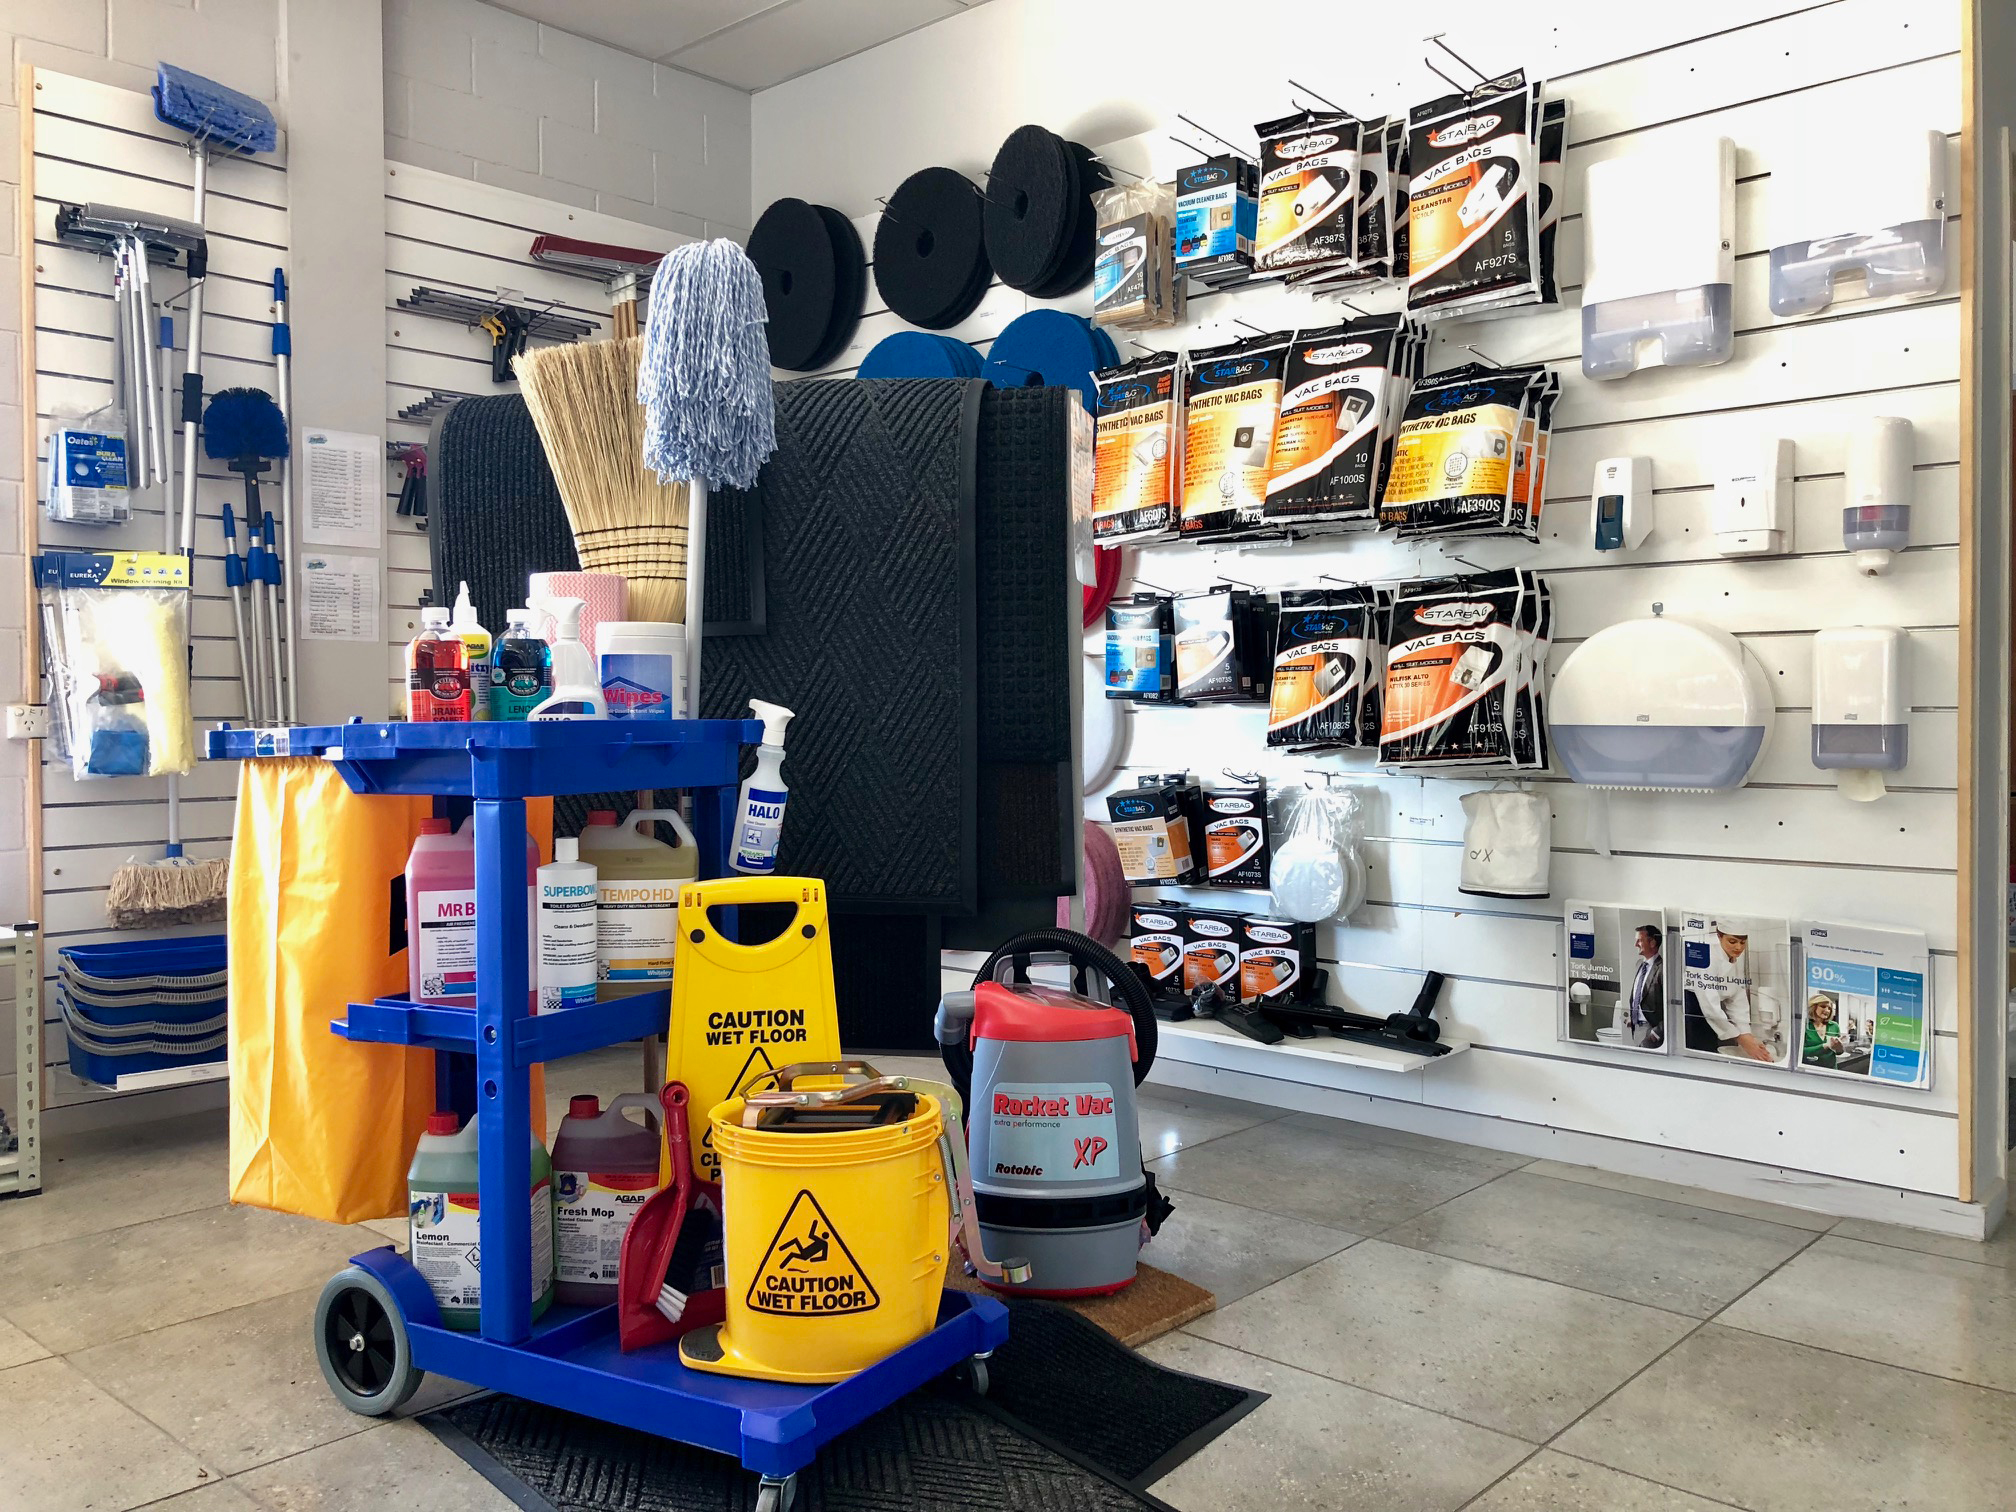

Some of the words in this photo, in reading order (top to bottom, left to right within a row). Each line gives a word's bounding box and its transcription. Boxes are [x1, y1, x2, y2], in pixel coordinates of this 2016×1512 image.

[1268, 168, 1291, 182] VAC
[1296, 157, 1329, 171] BAGS
[1424, 162, 1451, 181] VAC
[1456, 146, 1492, 166] BAGS
[1193, 172, 1218, 184] STARBAG
[1412, 191, 1427, 201] WILL
[1428, 187, 1442, 197] SUIT
[1443, 180, 1469, 193] MODELS
[1178, 198, 1195, 208] VACUUM
[1196, 194, 1215, 204] CLEANER
[1215, 191, 1228, 201] BAGS
[1412, 197, 1453, 214] CLEANSTAR
[1338, 214, 1344, 223] 5
[1370, 214, 1376, 223] 5
[1313, 233, 1345, 246] AF387S
[1358, 232, 1380, 245] 387S
[1401, 234, 1407, 243] 5
[1504, 231, 1513, 242] 5
[1218, 253, 1234, 263] AF1082
[1475, 253, 1517, 272] AF927S
[1214, 364, 1253, 378] STARBAG
[1295, 382, 1320, 399] VAC
[1325, 375, 1360, 389] BAGS
[1224, 392, 1240, 405] VAC
[1240, 388, 1263, 403] BAGS
[1130, 414, 1144, 427] VAC
[1145, 410, 1164, 423] BAGS
[1451, 413, 1477, 426] BAGS
[67, 436, 94, 446] Oates
[1356, 453, 1367, 463] 10
[1330, 474, 1365, 486] AF1000S
[1461, 499, 1500, 514] AF390S
[1388, 511, 1408, 522] BAGS
[1425, 605, 1489, 619] STARBAG
[1405, 637, 1436, 651] VAC
[1442, 632, 1486, 643] BAGS
[1287, 647, 1307, 659] VAC
[1311, 642, 1339, 652] BAGS
[1390, 675, 1411, 683] NILFISK
[602, 688, 663, 708] Wipes
[432, 707, 464, 716] ORANGE
[1345, 702, 1350, 712] 5
[1366, 703, 1372, 712] 5
[1494, 701, 1500, 710] 5
[1516, 708, 1523, 717] 5
[1320, 722, 1350, 731] AF1082S
[1467, 723, 1503, 735] AF913S
[748, 804, 780, 819] HALO
[1254, 859, 1260, 867] 5
[599, 889, 651, 901] TEMPO
[652, 889, 674, 900] HD
[438, 903, 463, 917] MR
[1141, 918, 1174, 927] STARBAG
[1194, 924, 1229, 933] STARBAG
[1251, 930, 1288, 940] STARBAG
[1570, 961, 1586, 971] Tork
[1588, 964, 1614, 973] Jumbo
[1570, 970, 1580, 978] T1
[1581, 971, 1609, 981] System
[1685, 971, 1702, 980] Tork
[1704, 973, 1725, 985] Soap
[1727, 976, 1752, 986] Liquid
[1811, 966, 1846, 983] 90%
[1685, 979, 1695, 987] S1
[1697, 981, 1728, 992] System
[708, 1009, 805, 1030] CAUTION
[706, 1030, 743, 1046] WET
[750, 1028, 807, 1044] FLOOR
[993, 1093, 1069, 1117] Rocket
[1075, 1094, 1113, 1116] Vac
[1012, 1120, 1061, 1129] performance
[1073, 1136, 1108, 1170] XP
[995, 1162, 1044, 1176] Rotobic
[615, 1195, 646, 1203] AGAR
[557, 1206, 588, 1216] Fresh
[591, 1207, 615, 1219] Mop
[417, 1231, 449, 1242] Lemon
[766, 1274, 854, 1293] CAUTION
[757, 1290, 795, 1310] WET
[800, 1290, 867, 1311] FLOOR
